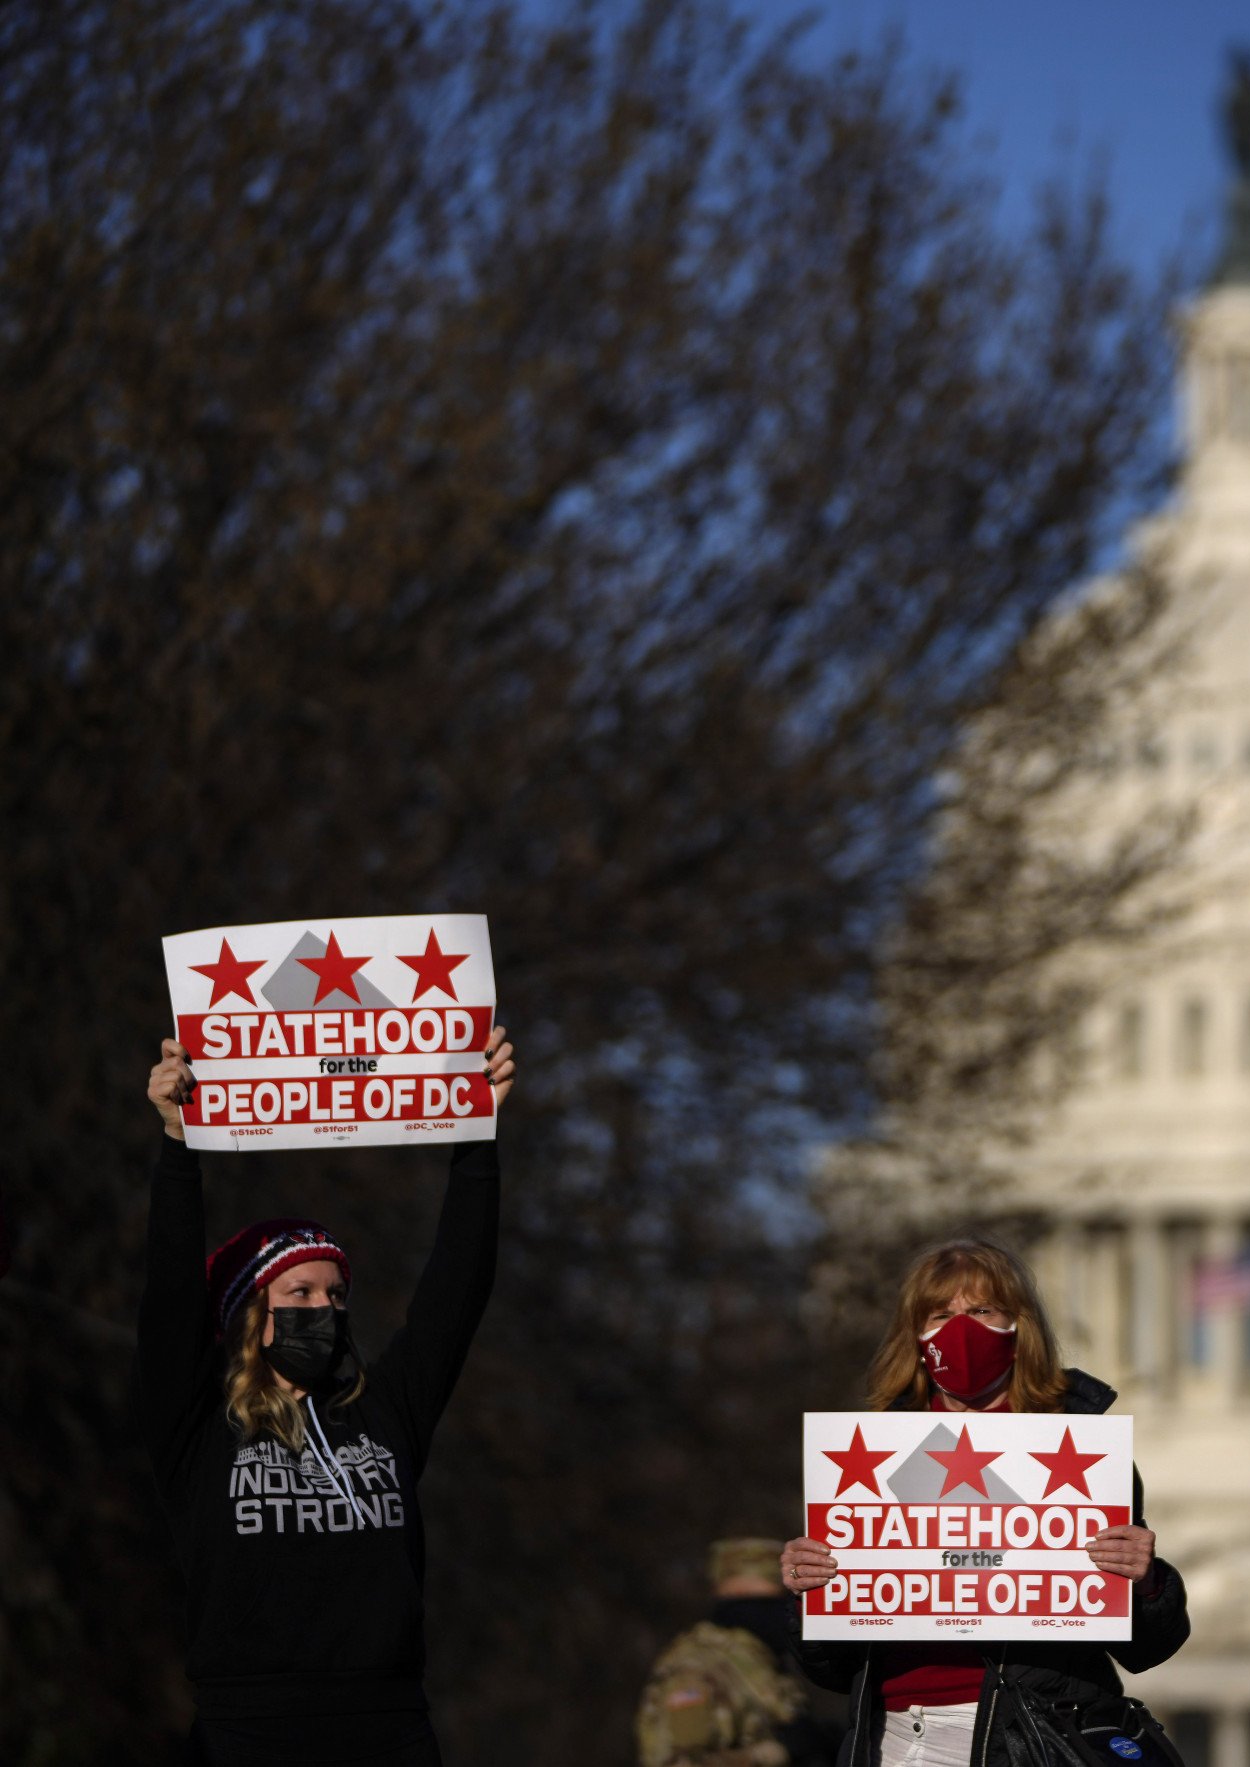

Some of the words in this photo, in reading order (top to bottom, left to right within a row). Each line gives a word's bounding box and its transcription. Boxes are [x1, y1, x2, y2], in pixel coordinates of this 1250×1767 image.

[201, 1009, 475, 1058] STATEHOOD
[319, 1058, 345, 1074] for
[348, 1057, 378, 1073] the
[201, 1080, 356, 1124] PEOPLE
[362, 1078, 416, 1120] OF
[422, 1076, 474, 1118] DC
[229, 1127, 274, 1137] @51stDC
[313, 1124, 358, 1134] @51for51
[404, 1121, 455, 1131] @DC_Vote
[235, 1492, 405, 1535] STRONG
[825, 1504, 1109, 1549] STATEHOOD
[942, 1551, 970, 1567] for
[971, 1551, 1003, 1567] the
[824, 1573, 979, 1614] PEOPLE
[986, 1573, 1043, 1614] OF
[1050, 1574, 1106, 1615] DC
[849, 1618, 894, 1627] @51stDC
[935, 1618, 982, 1627] @51for51
[1031, 1618, 1086, 1628] @DC_Vote
